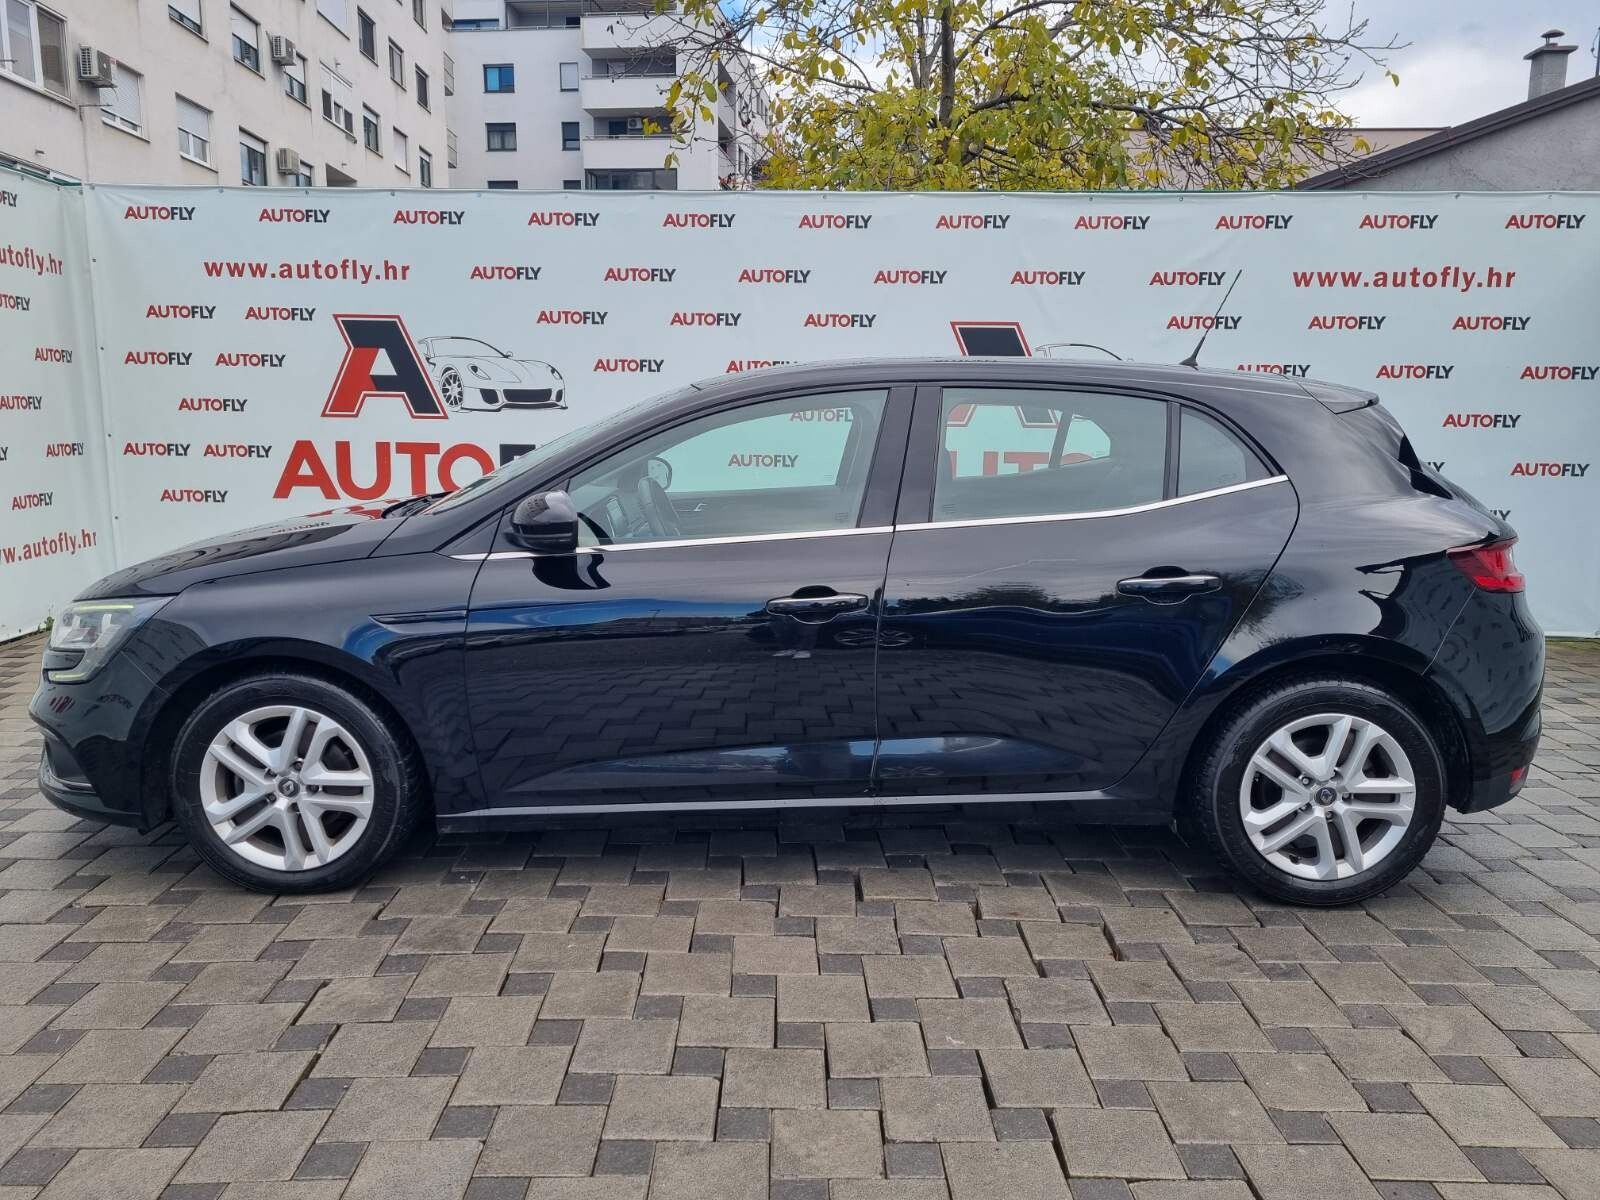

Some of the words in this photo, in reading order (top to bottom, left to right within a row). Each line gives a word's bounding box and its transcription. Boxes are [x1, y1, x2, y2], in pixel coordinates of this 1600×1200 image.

[124, 206, 195, 220] AUTOFLY
[259, 209, 330, 223] AUTOFLY
[393, 211, 464, 224] AUTOFLY
[528, 213, 600, 226] AUTOFLY
[663, 214, 736, 227] AUTOFLY
[799, 215, 872, 229] AUTOFLY
[936, 215, 1010, 229] AUTOFLY
[1075, 216, 1150, 229] AUTOFLY
[1216, 215, 1293, 229] AUTOFLY
[1359, 215, 1439, 229] AUTOFLY
[1505, 215, 1586, 229] AUTOFLY
[204, 259, 409, 284] www.autofly.hr
[471, 266, 541, 280] AUTOFLY
[604, 268, 676, 282] AUTOFLY
[739, 270, 811, 283] AUTOFLY
[874, 271, 947, 284] AUTOFLY
[1011, 271, 1085, 285] AUTOFLY
[1149, 272, 1226, 285] AUTOFLY
[1293, 266, 1515, 292] www.autofly.hr
[0, 294, 30, 311] TOFLY
[146, 305, 216, 319] AUTOFLY
[245, 307, 316, 321] AUTOFLY
[537, 311, 608, 324] AUTOFLY
[670, 313, 741, 326] AUTOFLY
[804, 314, 876, 327] AUTOFLY
[1167, 315, 1242, 330] AUTOFLY
[1308, 316, 1386, 329] AUTOFLY
[1452, 317, 1531, 330] AUTOFLY
[35, 348, 72, 363] AUTOFLY
[125, 352, 192, 365] AUTOFLY
[216, 353, 285, 367] AUTOFLY
[594, 359, 664, 372] AUTOFLY
[1376, 365, 1454, 379] AUTOFLY
[1520, 367, 1600, 380] AUTOFLY
[0, 396, 42, 409] AUTOFLY
[179, 398, 247, 412] AUTOFLY
[790, 408, 854, 422] AUTOFL
[1443, 414, 1521, 428] AUTOFLY
[46, 443, 83, 457] AUTOFLY
[124, 443, 190, 456] AUTOFLY
[204, 445, 272, 458] AUTOFLY
[728, 454, 798, 467] AUTOFLY
[1511, 463, 1590, 477] AUTOFLY
[12, 492, 53, 510] AUTOFLY
[161, 490, 228, 502] AUTOFLY
[0, 529, 96, 564] w.autofly.hr
